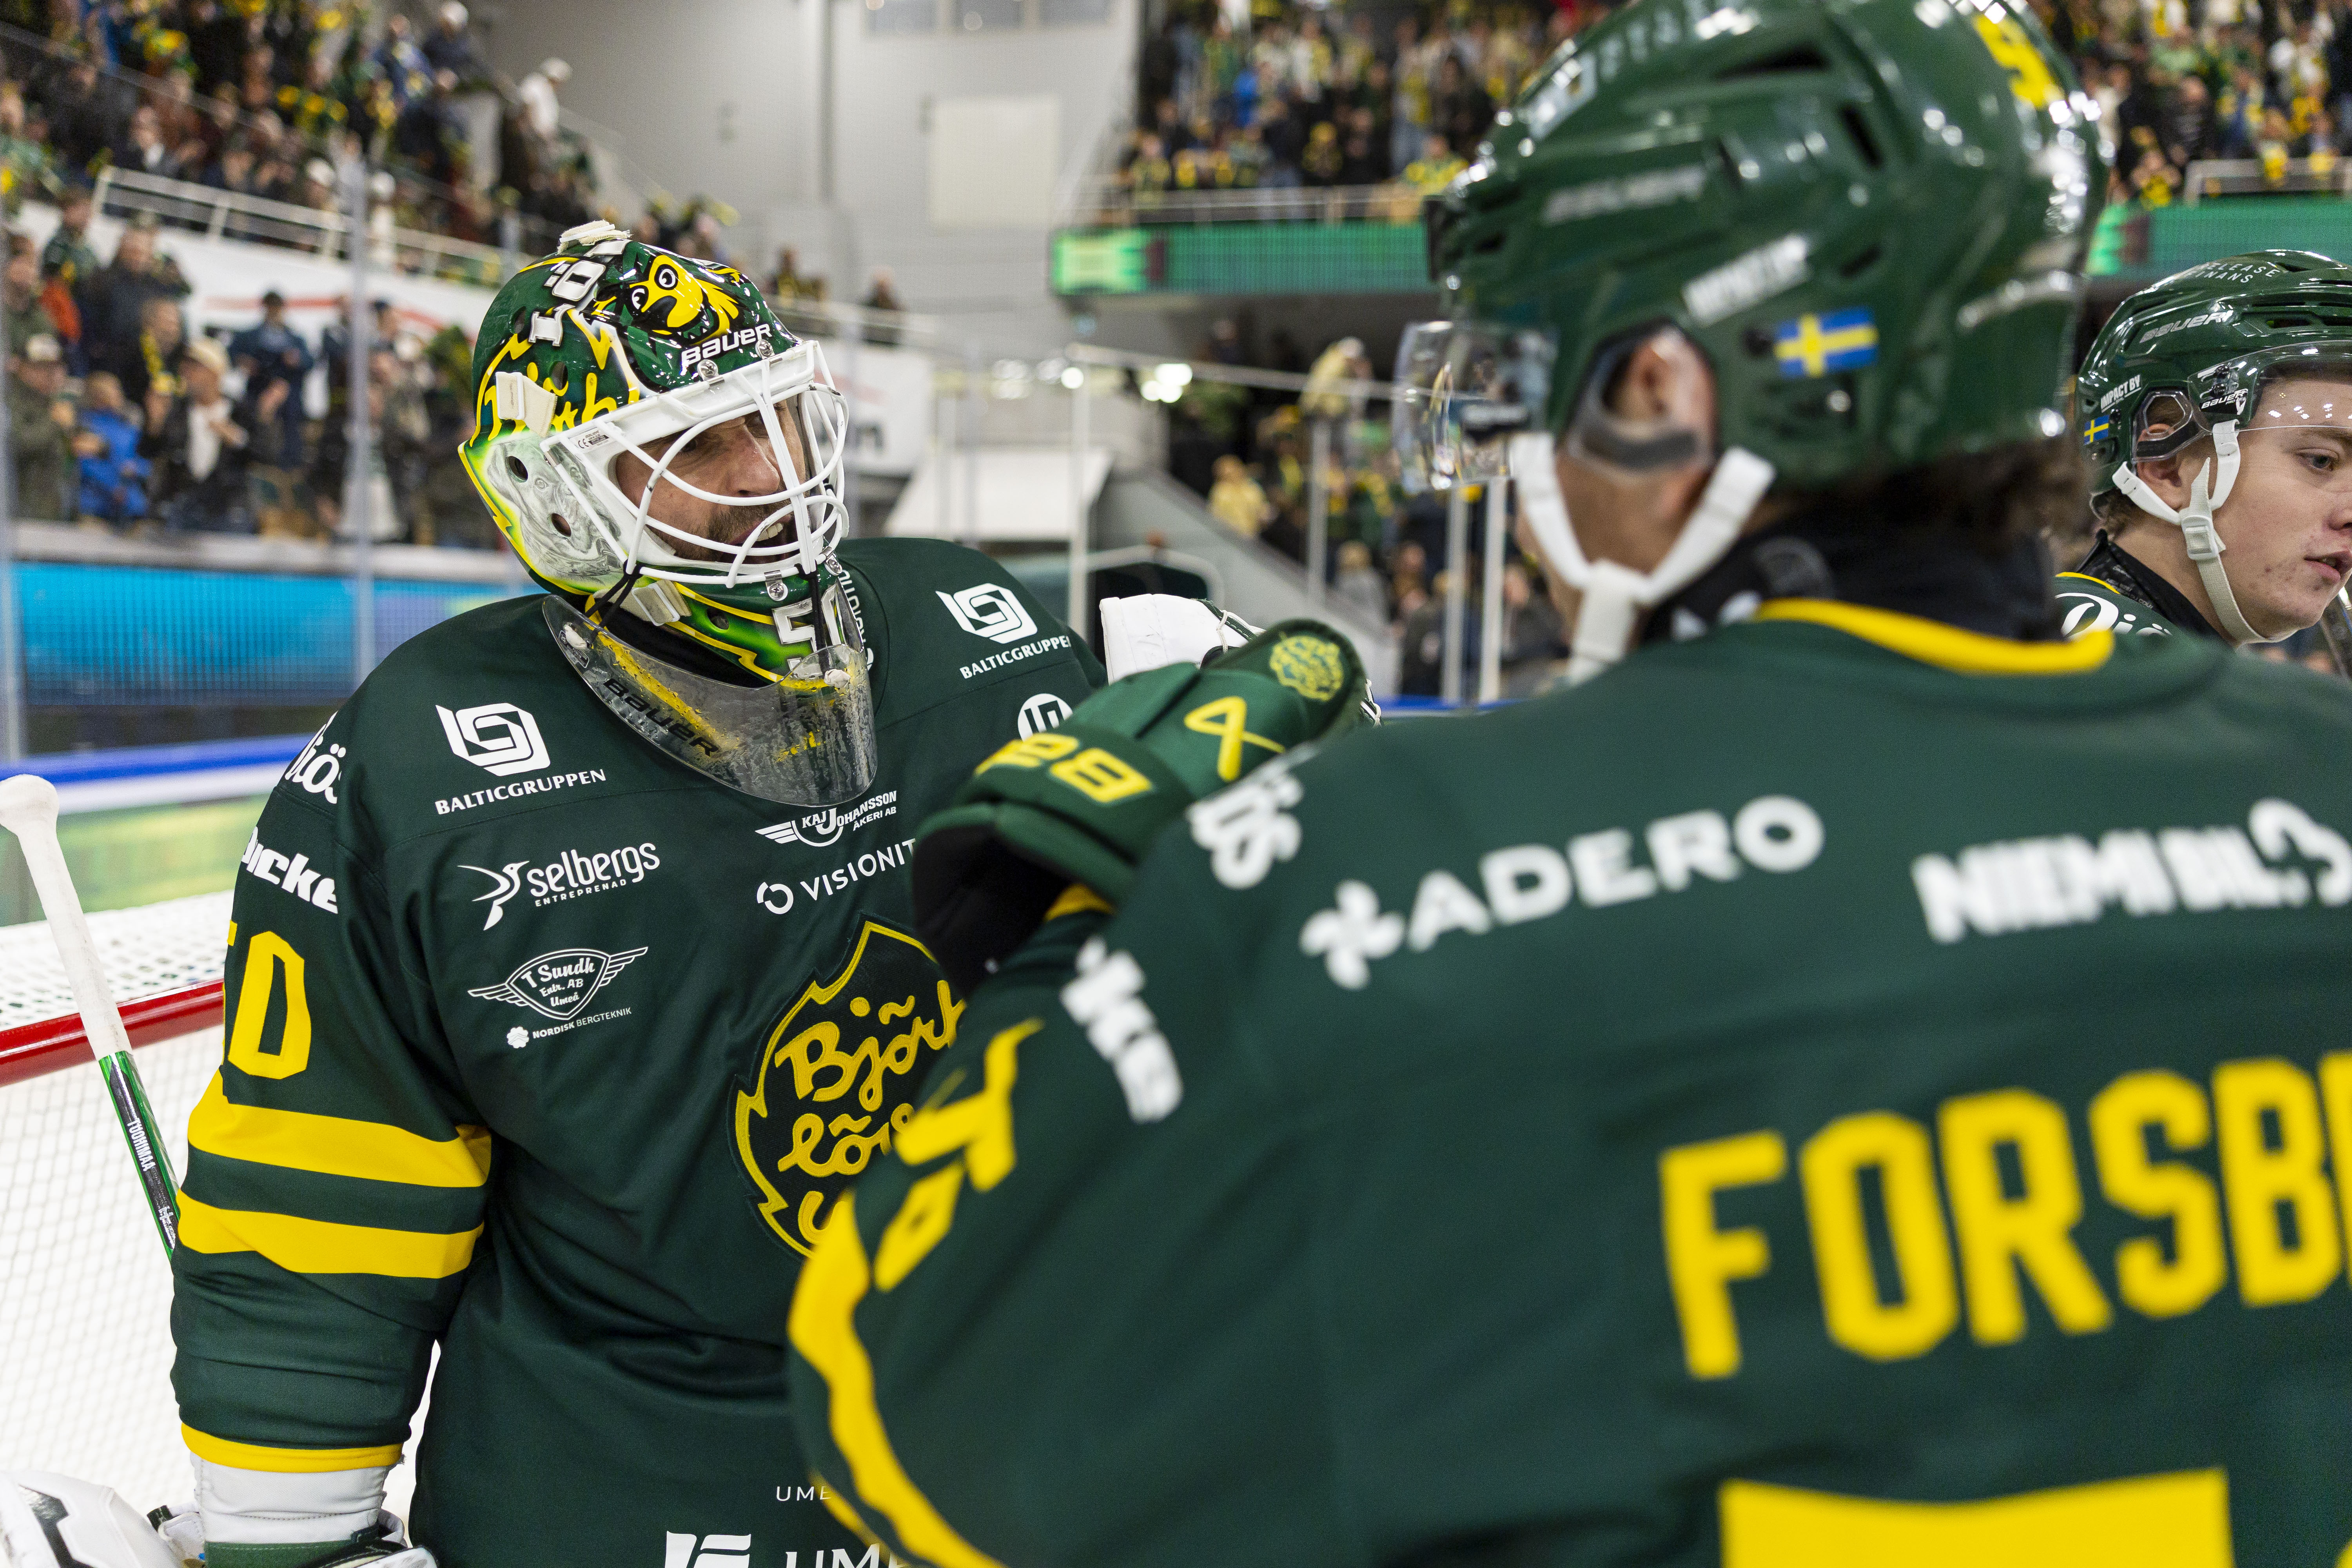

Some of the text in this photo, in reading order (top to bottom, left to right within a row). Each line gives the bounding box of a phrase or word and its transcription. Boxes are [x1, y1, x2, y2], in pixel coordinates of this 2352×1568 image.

[435, 769, 606, 815] BALTICGRUPPEN
[853, 806, 897, 831] ÅKERI AB
[1406, 793, 1825, 952] ADERO
[535, 878, 627, 907] ENTREPRENAD
[521, 957, 595, 988] T Sundh
[539, 978, 584, 997] Entr. AB
[550, 992, 580, 1007] Umeå
[532, 1007, 632, 1039] NORDISK BERGTEKNIK
[127, 1117, 156, 1172] TUOHIMAA
